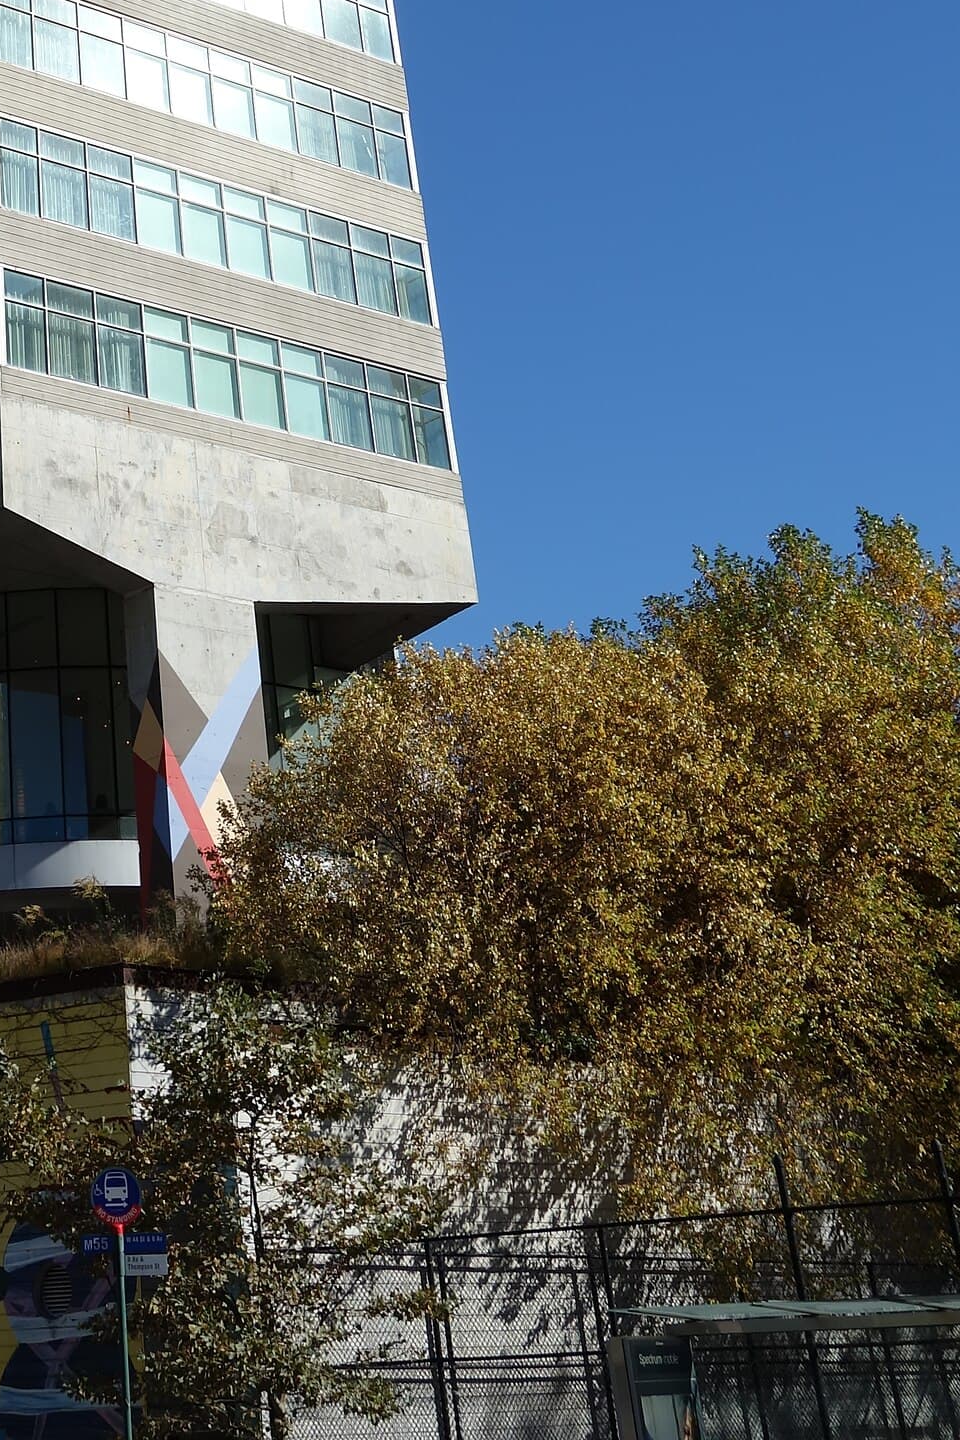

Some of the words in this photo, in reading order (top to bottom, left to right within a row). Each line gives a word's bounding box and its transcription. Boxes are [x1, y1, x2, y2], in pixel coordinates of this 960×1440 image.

[97, 1207, 106, 1218] NO
[106, 1207, 138, 1222] STANDING
[84, 1237, 109, 1251] M55
